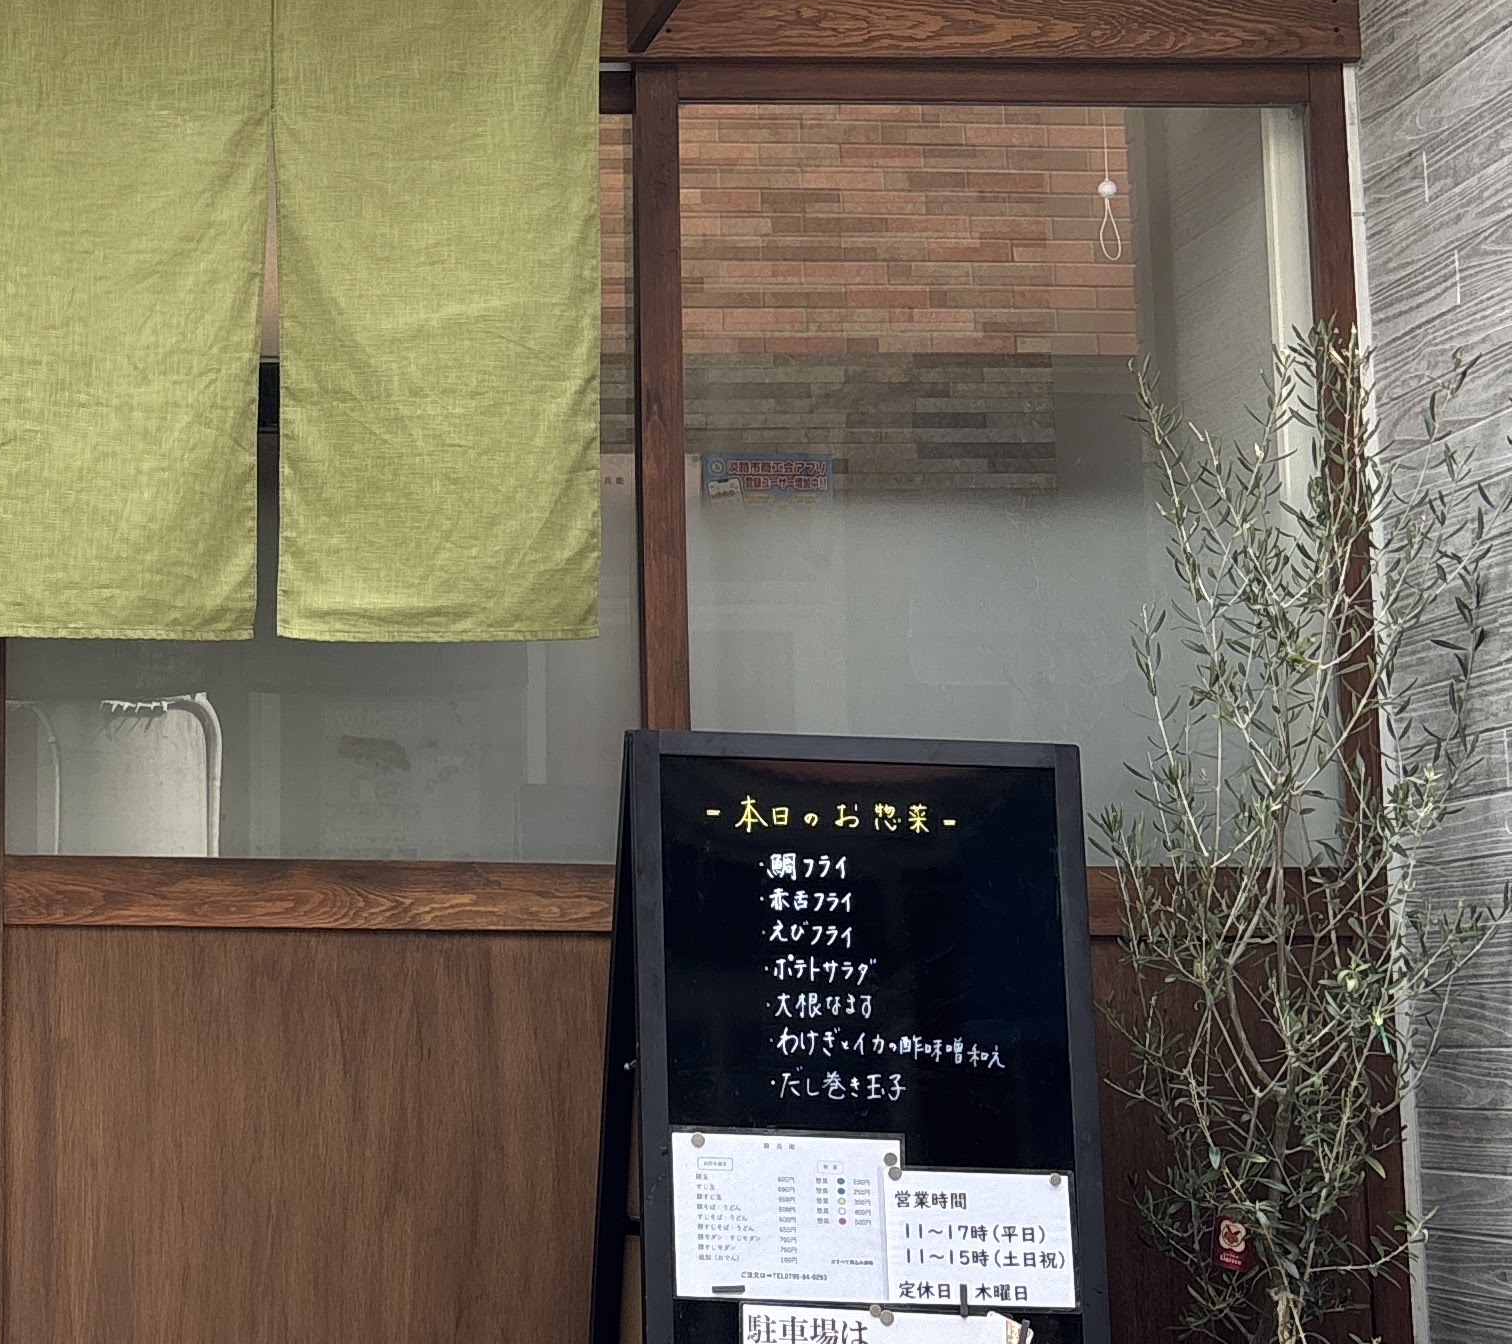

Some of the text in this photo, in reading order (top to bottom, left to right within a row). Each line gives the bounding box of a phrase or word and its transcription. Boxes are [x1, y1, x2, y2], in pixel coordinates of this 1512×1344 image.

[894, 1190, 967, 1210] 営業時間
[898, 1280, 1028, 1302] 定休日 木曜日
